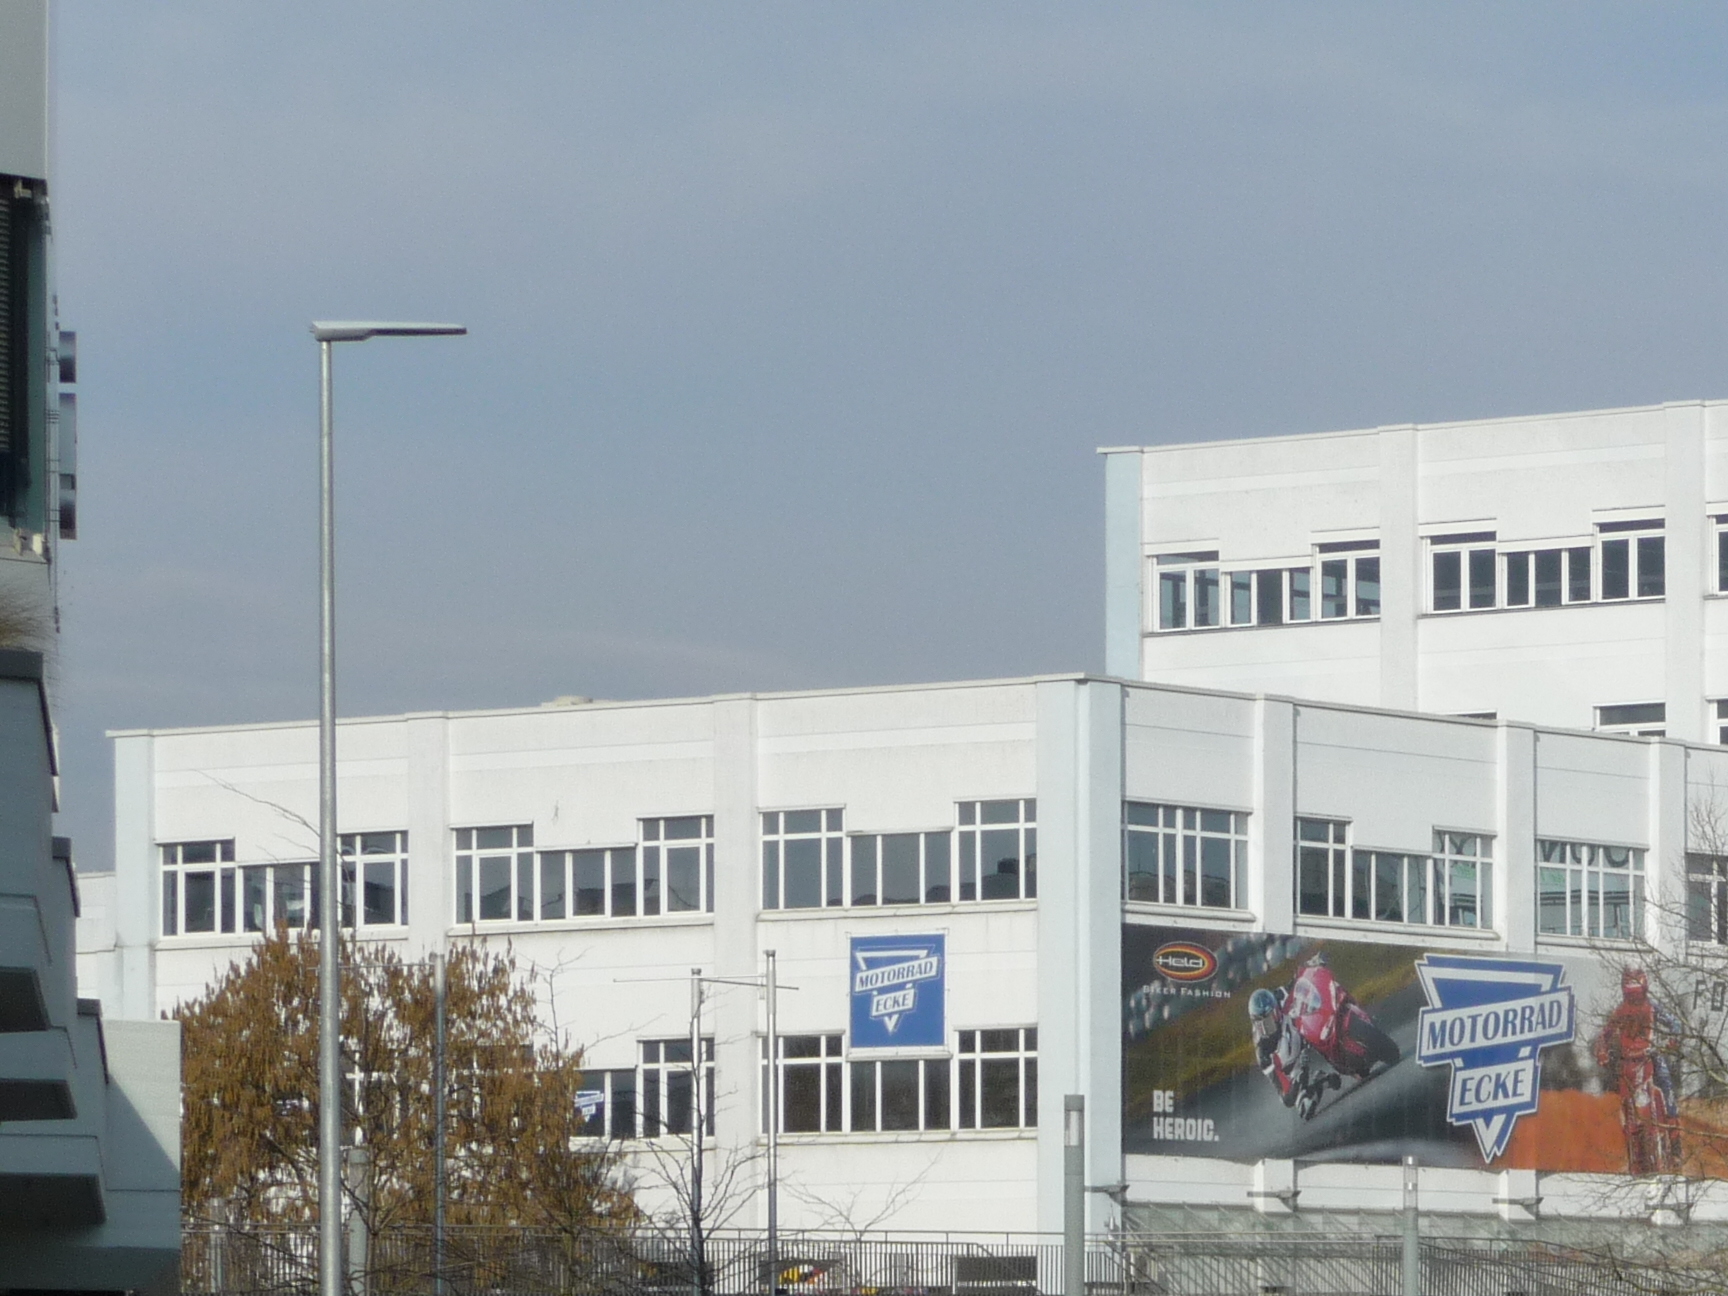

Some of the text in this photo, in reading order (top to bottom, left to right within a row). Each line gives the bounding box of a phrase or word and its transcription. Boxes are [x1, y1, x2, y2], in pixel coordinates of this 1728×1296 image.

[1156, 955, 1204, 968] Held
[859, 960, 934, 989] MOTORRAD
[875, 992, 910, 1013] ECKE
[1426, 999, 1563, 1051] MOTORRAD
[1459, 1068, 1526, 1107] ECKE
[1153, 1090, 1174, 1113] BE
[1153, 1117, 1219, 1142] HEROIC.
